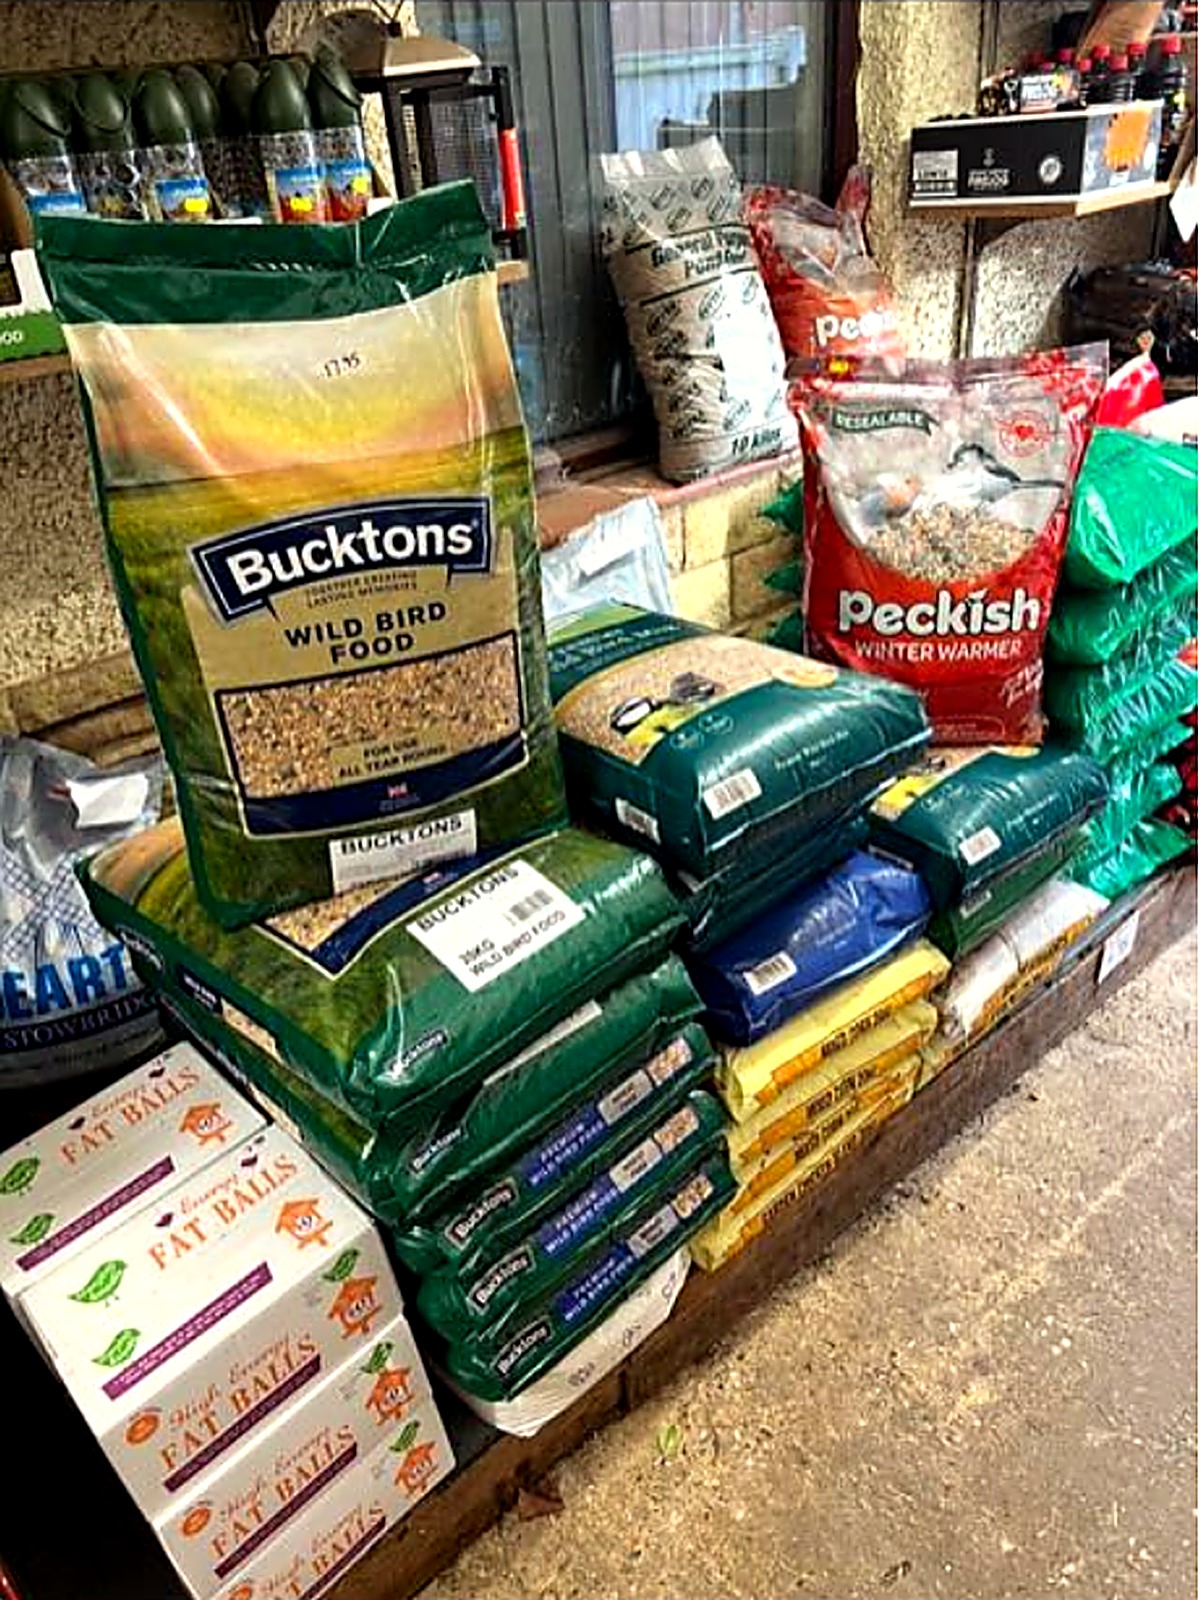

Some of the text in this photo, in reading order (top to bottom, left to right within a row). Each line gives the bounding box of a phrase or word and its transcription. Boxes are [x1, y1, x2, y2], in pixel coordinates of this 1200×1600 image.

[225, 518, 475, 597] Bucktons
[284, 602, 447, 648] WILD BIRD
[838, 587, 1041, 636] Peckish
[331, 633, 415, 664] FOOD
[855, 638, 1022, 663] WINTER WARMER
[340, 815, 462, 855] BUCKTONS
[416, 866, 519, 933] BUCKTONS
[0, 943, 127, 1020] EART
[469, 952, 503, 977] WILD
[502, 932, 532, 957] BIRD
[59, 1067, 200, 1165] FAT BALLS
[148, 1217, 208, 1271] FAT
[213, 1154, 298, 1225] BALLS
[160, 1409, 221, 1469] FAT
[229, 1334, 318, 1413] BALLS
[210, 1501, 264, 1557] FAT
[275, 1425, 355, 1501] BALLS
[311, 1501, 385, 1576] BALLS
